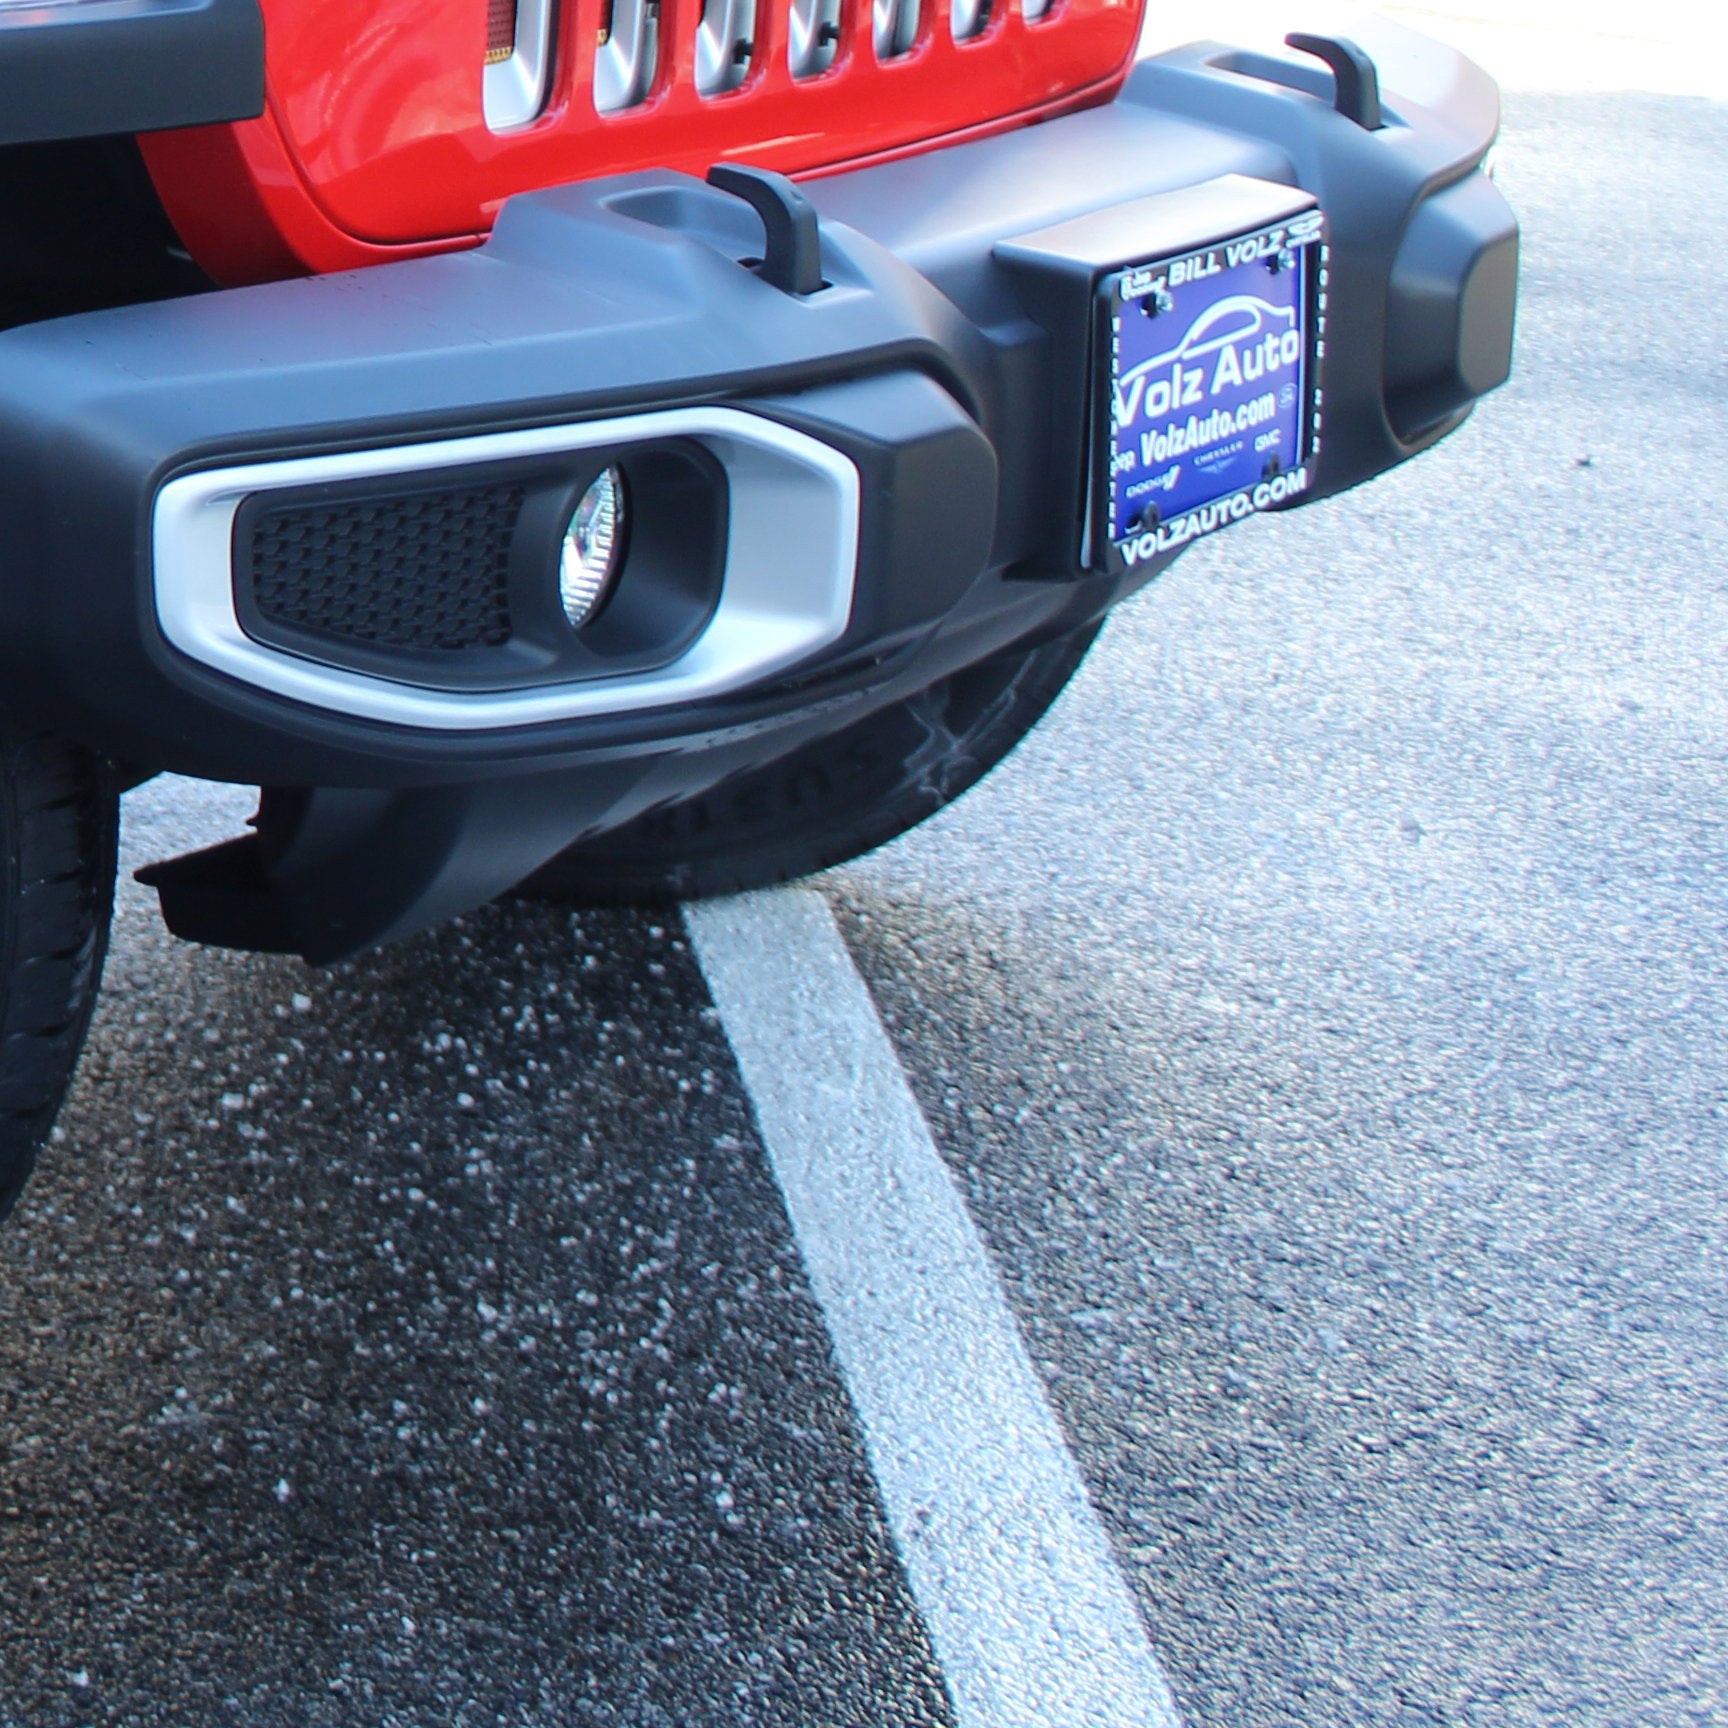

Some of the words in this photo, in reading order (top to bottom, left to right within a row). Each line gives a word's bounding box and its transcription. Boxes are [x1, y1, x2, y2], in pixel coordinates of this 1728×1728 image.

[1167, 252, 1222, 287] BILL
[1225, 229, 1285, 268] VOLZ
[1114, 362, 1204, 429] Volz
[1210, 329, 1300, 395] Auto
[1139, 392, 1276, 467] VolzAuto.com
[1121, 467, 1307, 566] VOLZAUTO.COM
